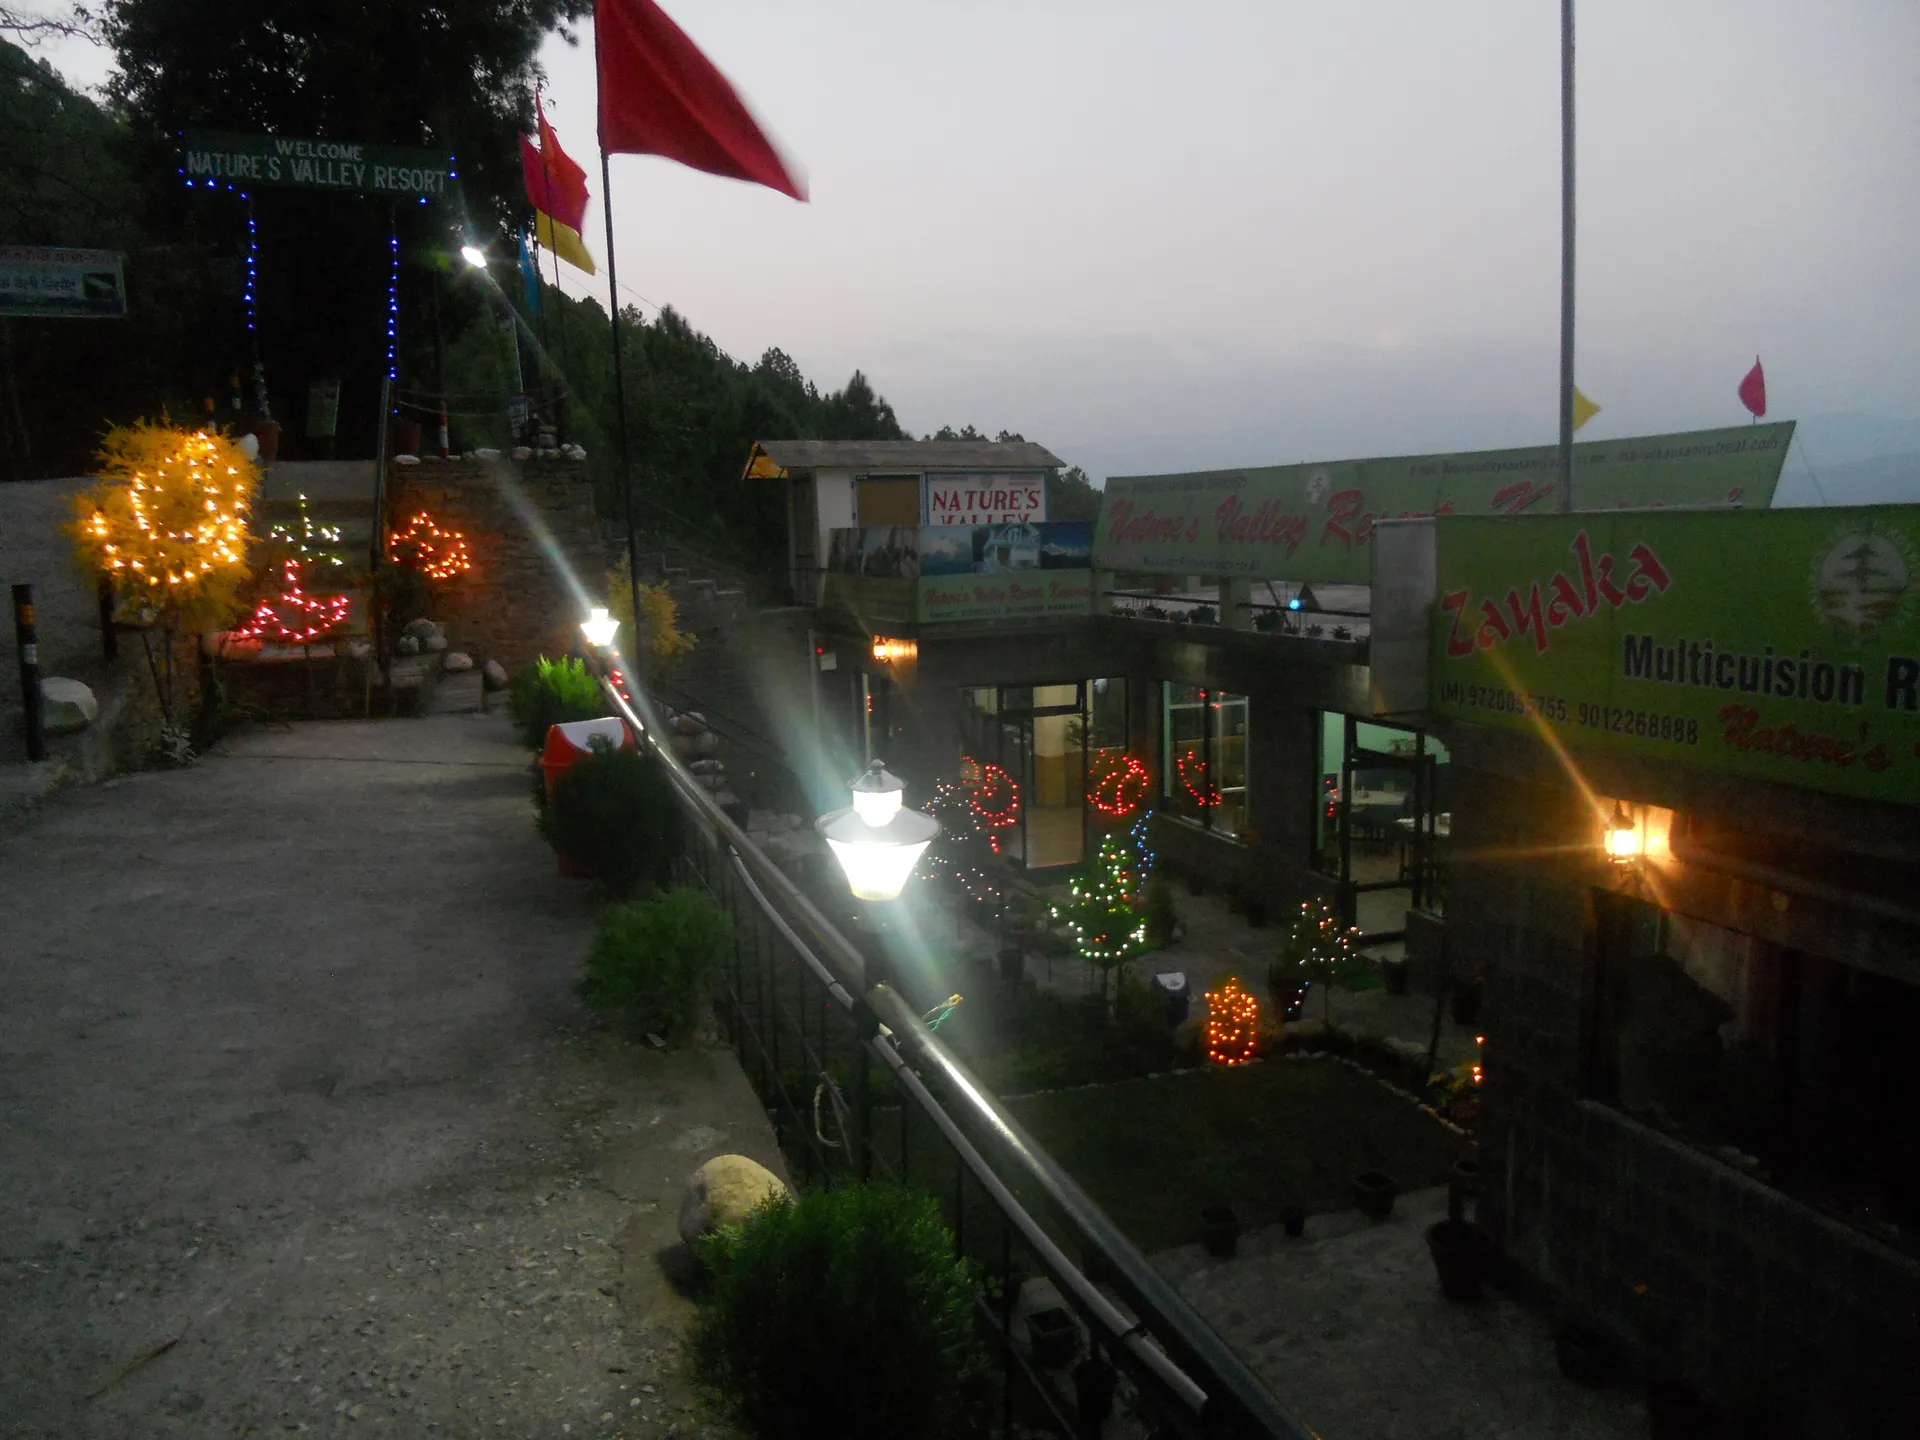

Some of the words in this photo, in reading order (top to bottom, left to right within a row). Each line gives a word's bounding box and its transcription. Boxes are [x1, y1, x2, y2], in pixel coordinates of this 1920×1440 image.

[186, 150, 282, 181] NATURE'S
[291, 160, 367, 187] VALLEY
[374, 166, 447, 193] RESORT
[274, 140, 364, 161] WELCOME
[932, 486, 1041, 511] NATURE'S
[1107, 497, 1201, 543] Nature's
[1213, 494, 1309, 560] Valley
[1441, 529, 1673, 659] Zayaka
[1624, 633, 1865, 706] Multicuision
[1440, 683, 1465, 708] (M)
[1577, 701, 1699, 746] 9012268888
[1718, 703, 1893, 773] Nature's
